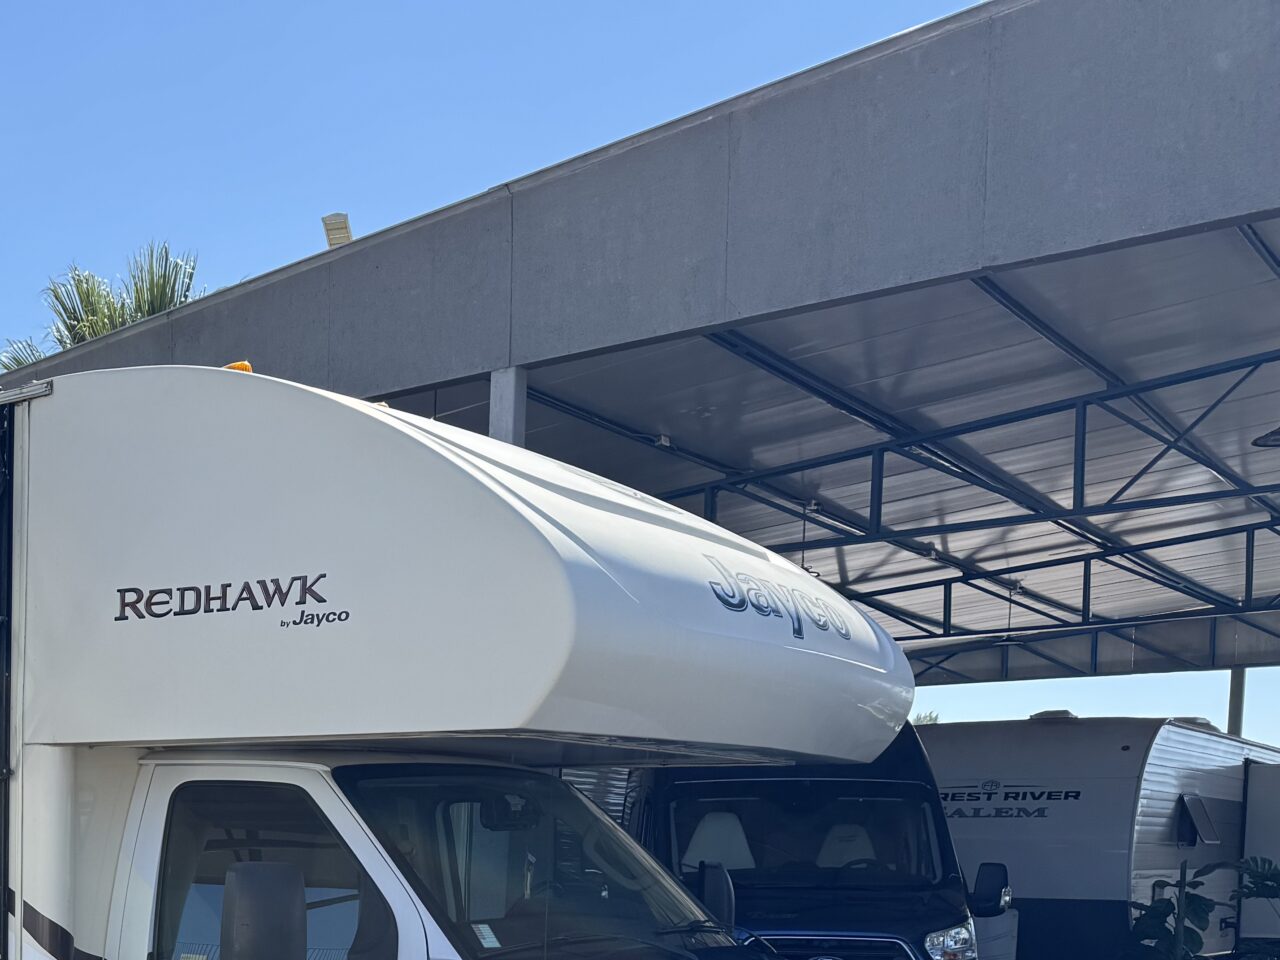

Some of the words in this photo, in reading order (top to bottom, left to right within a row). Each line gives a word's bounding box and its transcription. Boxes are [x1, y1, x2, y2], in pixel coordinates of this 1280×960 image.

[702, 552, 852, 640] Jayco
[280, 619, 291, 628] by
[292, 609, 350, 627] Jayco
[1004, 790, 1081, 801] RIVER
